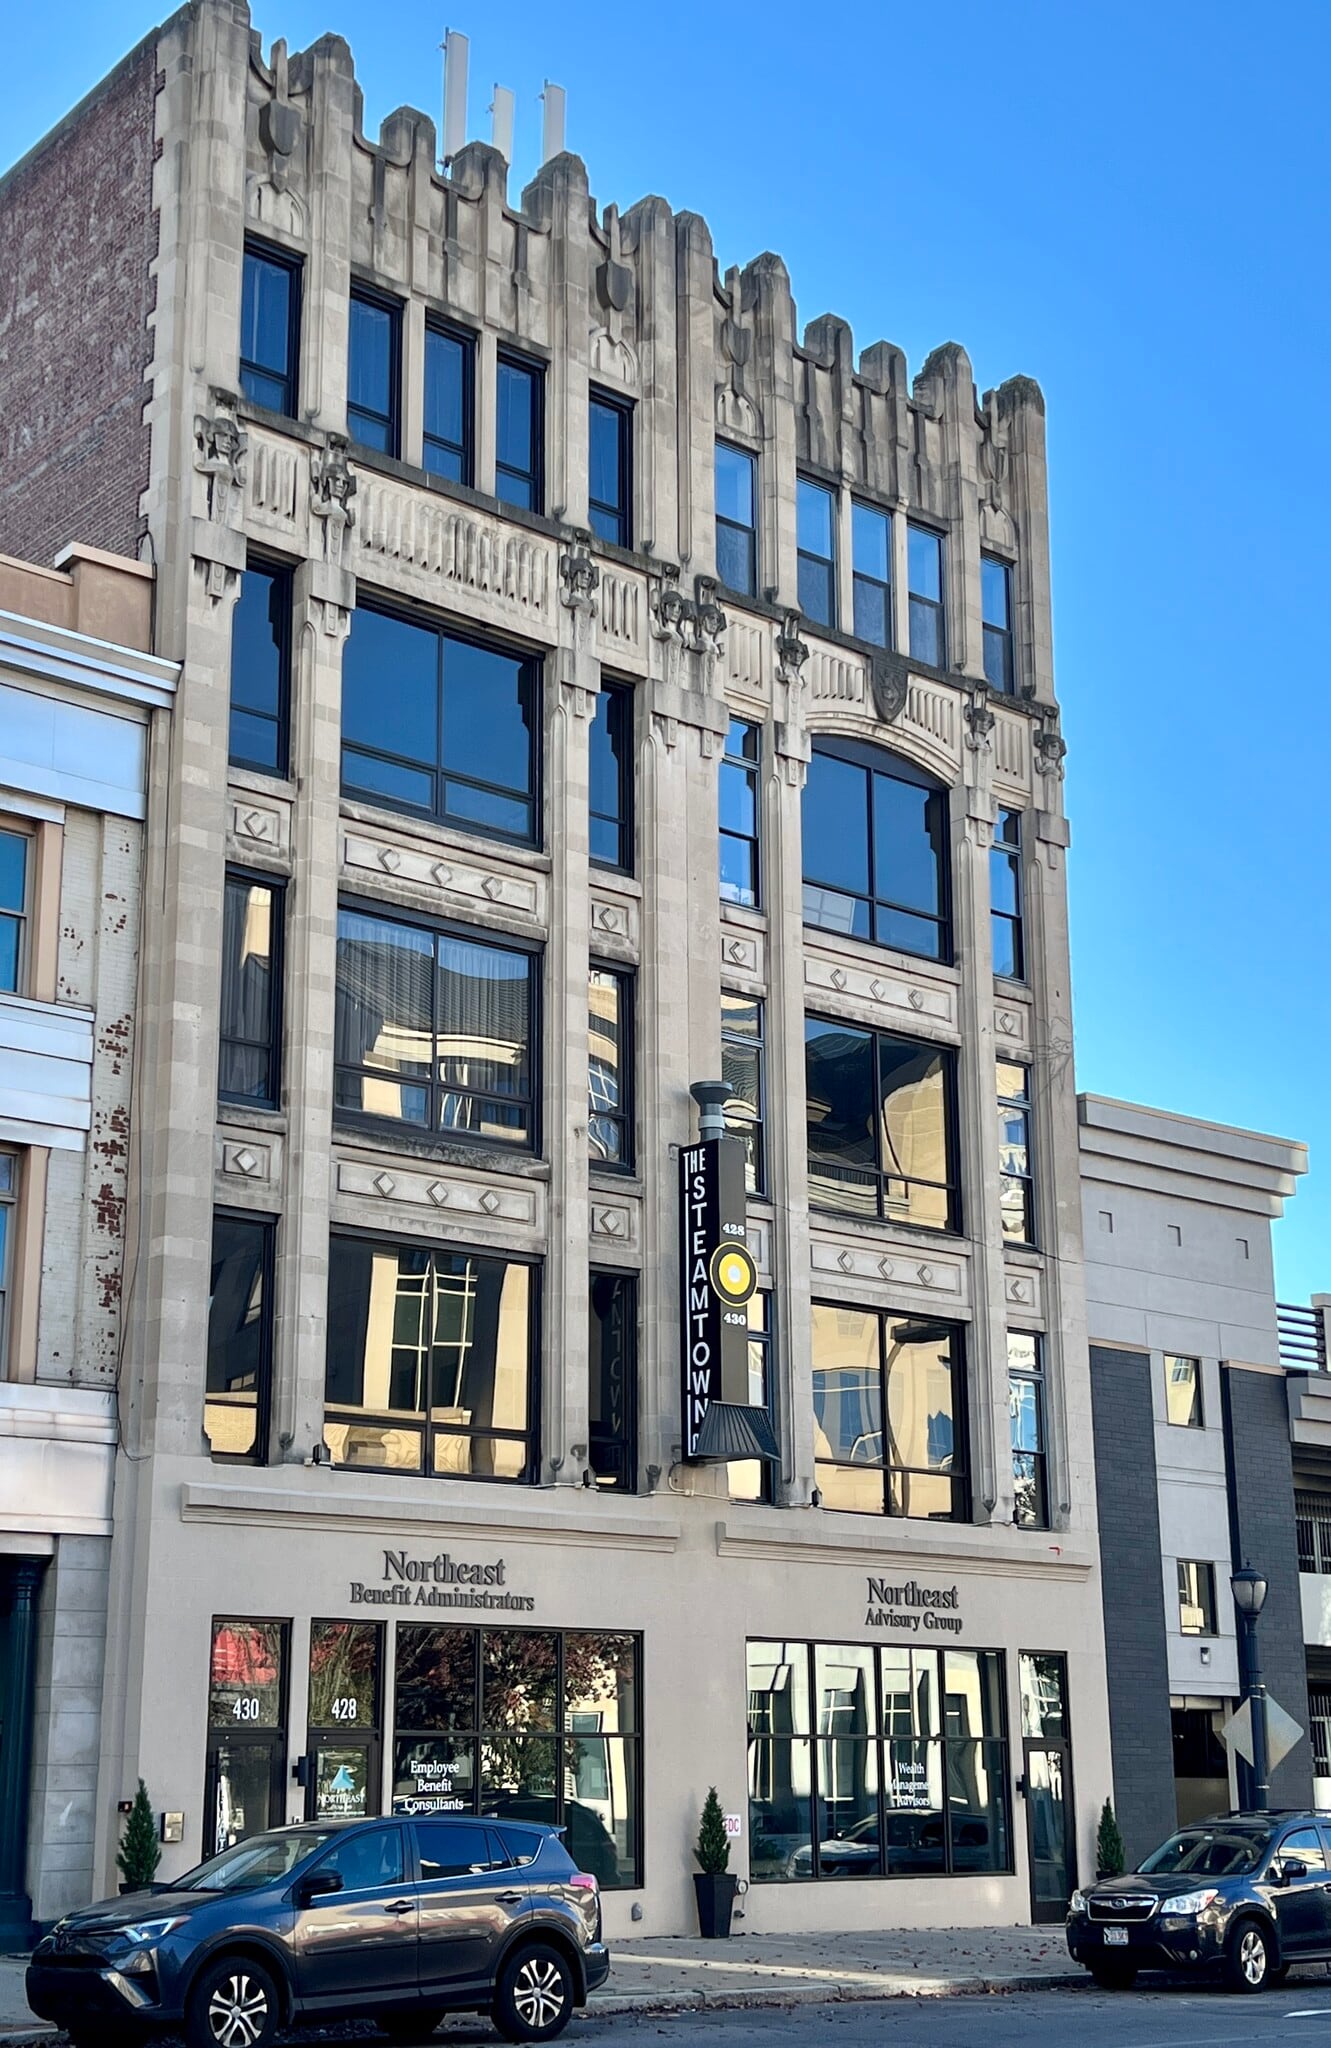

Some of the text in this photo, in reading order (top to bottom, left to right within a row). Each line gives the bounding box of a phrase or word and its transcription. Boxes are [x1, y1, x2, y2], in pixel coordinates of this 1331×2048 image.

[683, 1148, 706, 1183] THE
[722, 1223, 745, 1236] 428
[691, 1176, 710, 1423] STEAMTOWN
[723, 1312, 746, 1326] 430
[382, 1550, 506, 1586] Northeast
[350, 1582, 535, 1612] Benefit Administrators
[867, 1577, 959, 1609] Northeast
[865, 1607, 963, 1635] Advisory Group
[232, 1697, 259, 1720] 430
[331, 1697, 357, 1720] 428
[410, 1760, 460, 1778] Employee
[899, 1762, 925, 1774] Wealth
[418, 1778, 453, 1792] Benefit
[404, 1797, 464, 1811] Consultants
